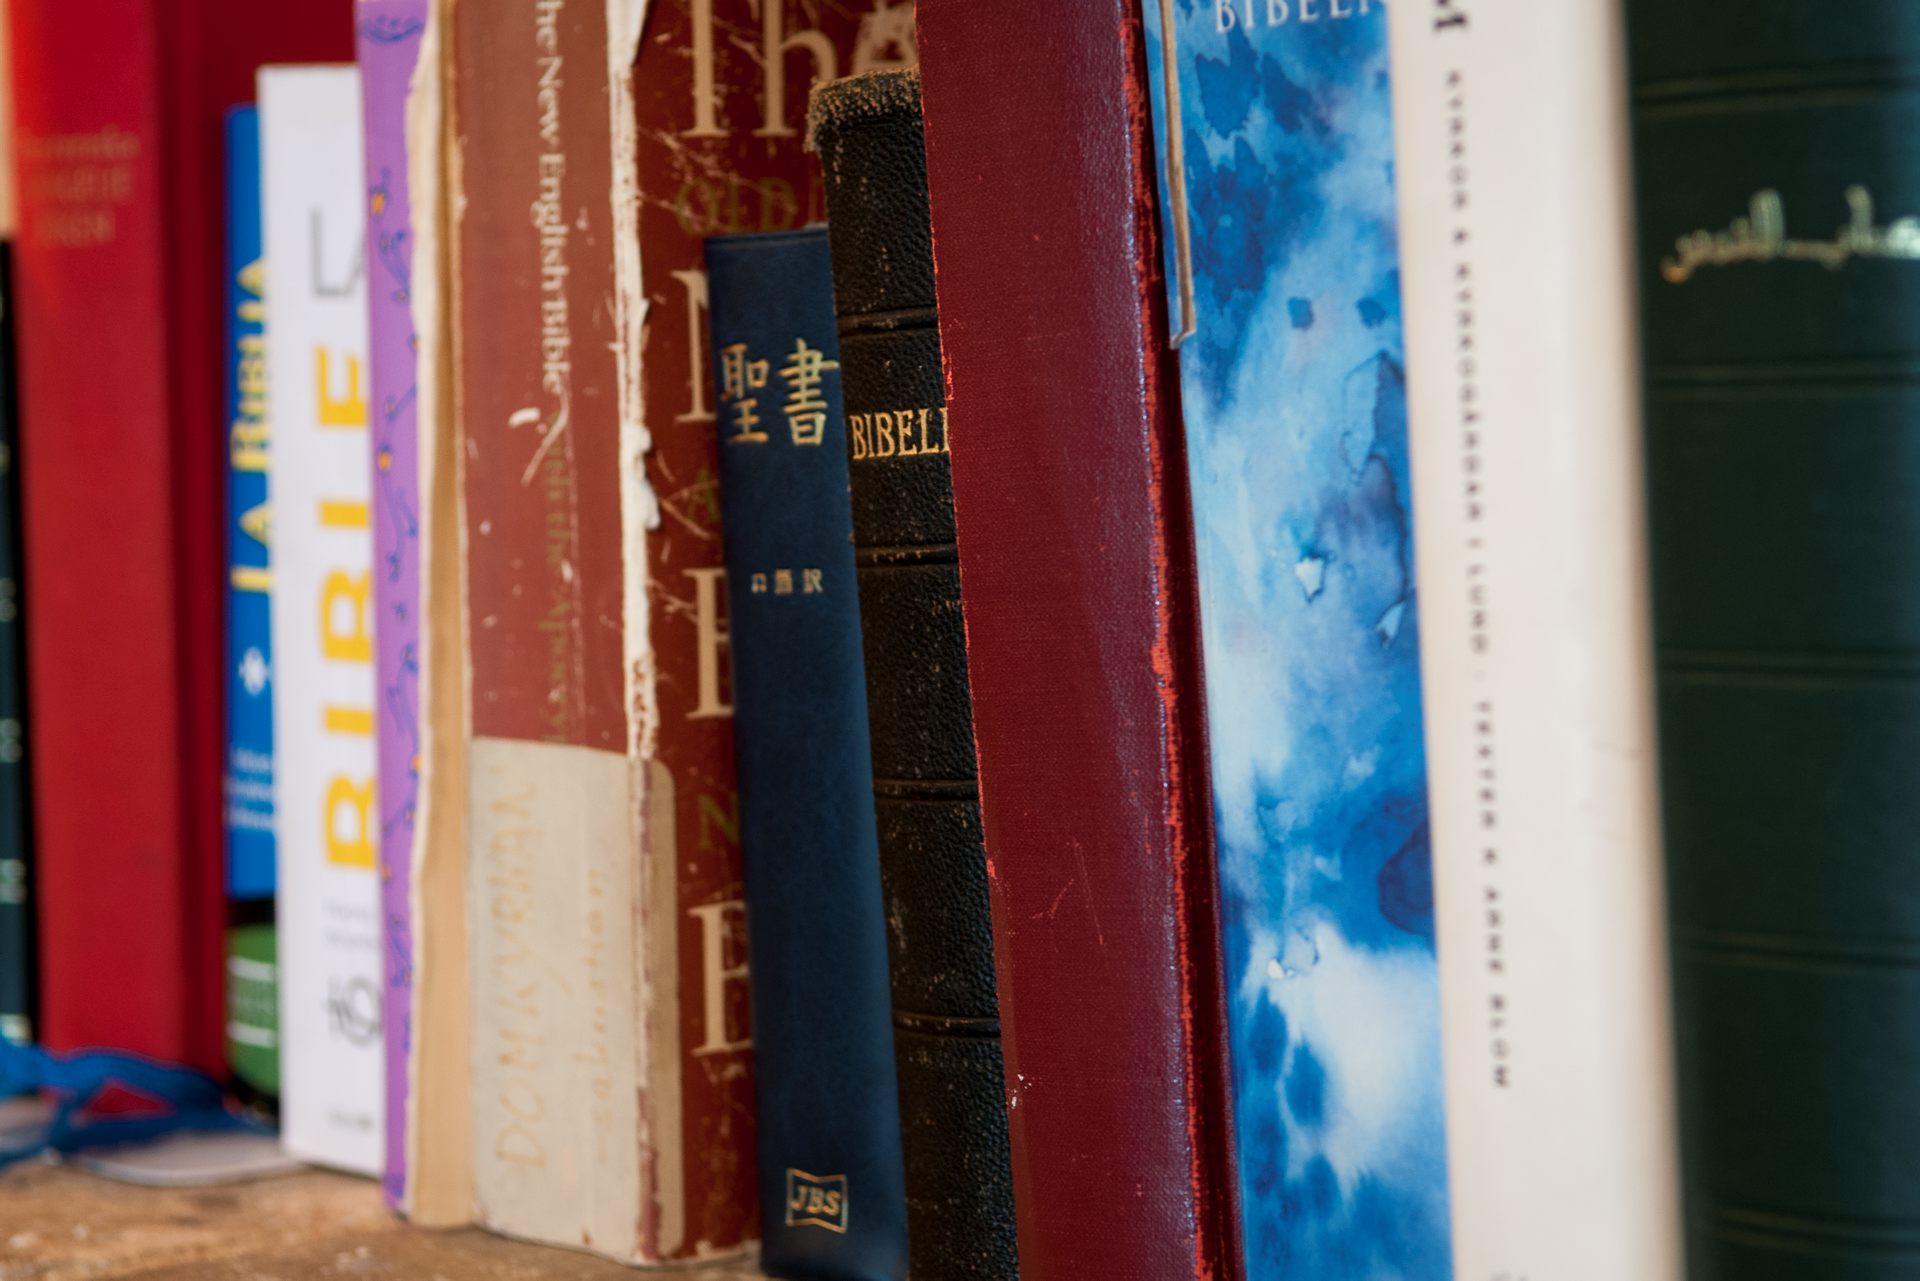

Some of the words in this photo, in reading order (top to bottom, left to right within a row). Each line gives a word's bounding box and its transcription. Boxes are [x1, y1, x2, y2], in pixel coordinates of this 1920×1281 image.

[536, 56, 564, 144] New
[529, 152, 572, 291] English
[541, 299, 573, 395] Bible
[720, 337, 840, 447] 聖書
[790, 1184, 842, 1217] JBS
